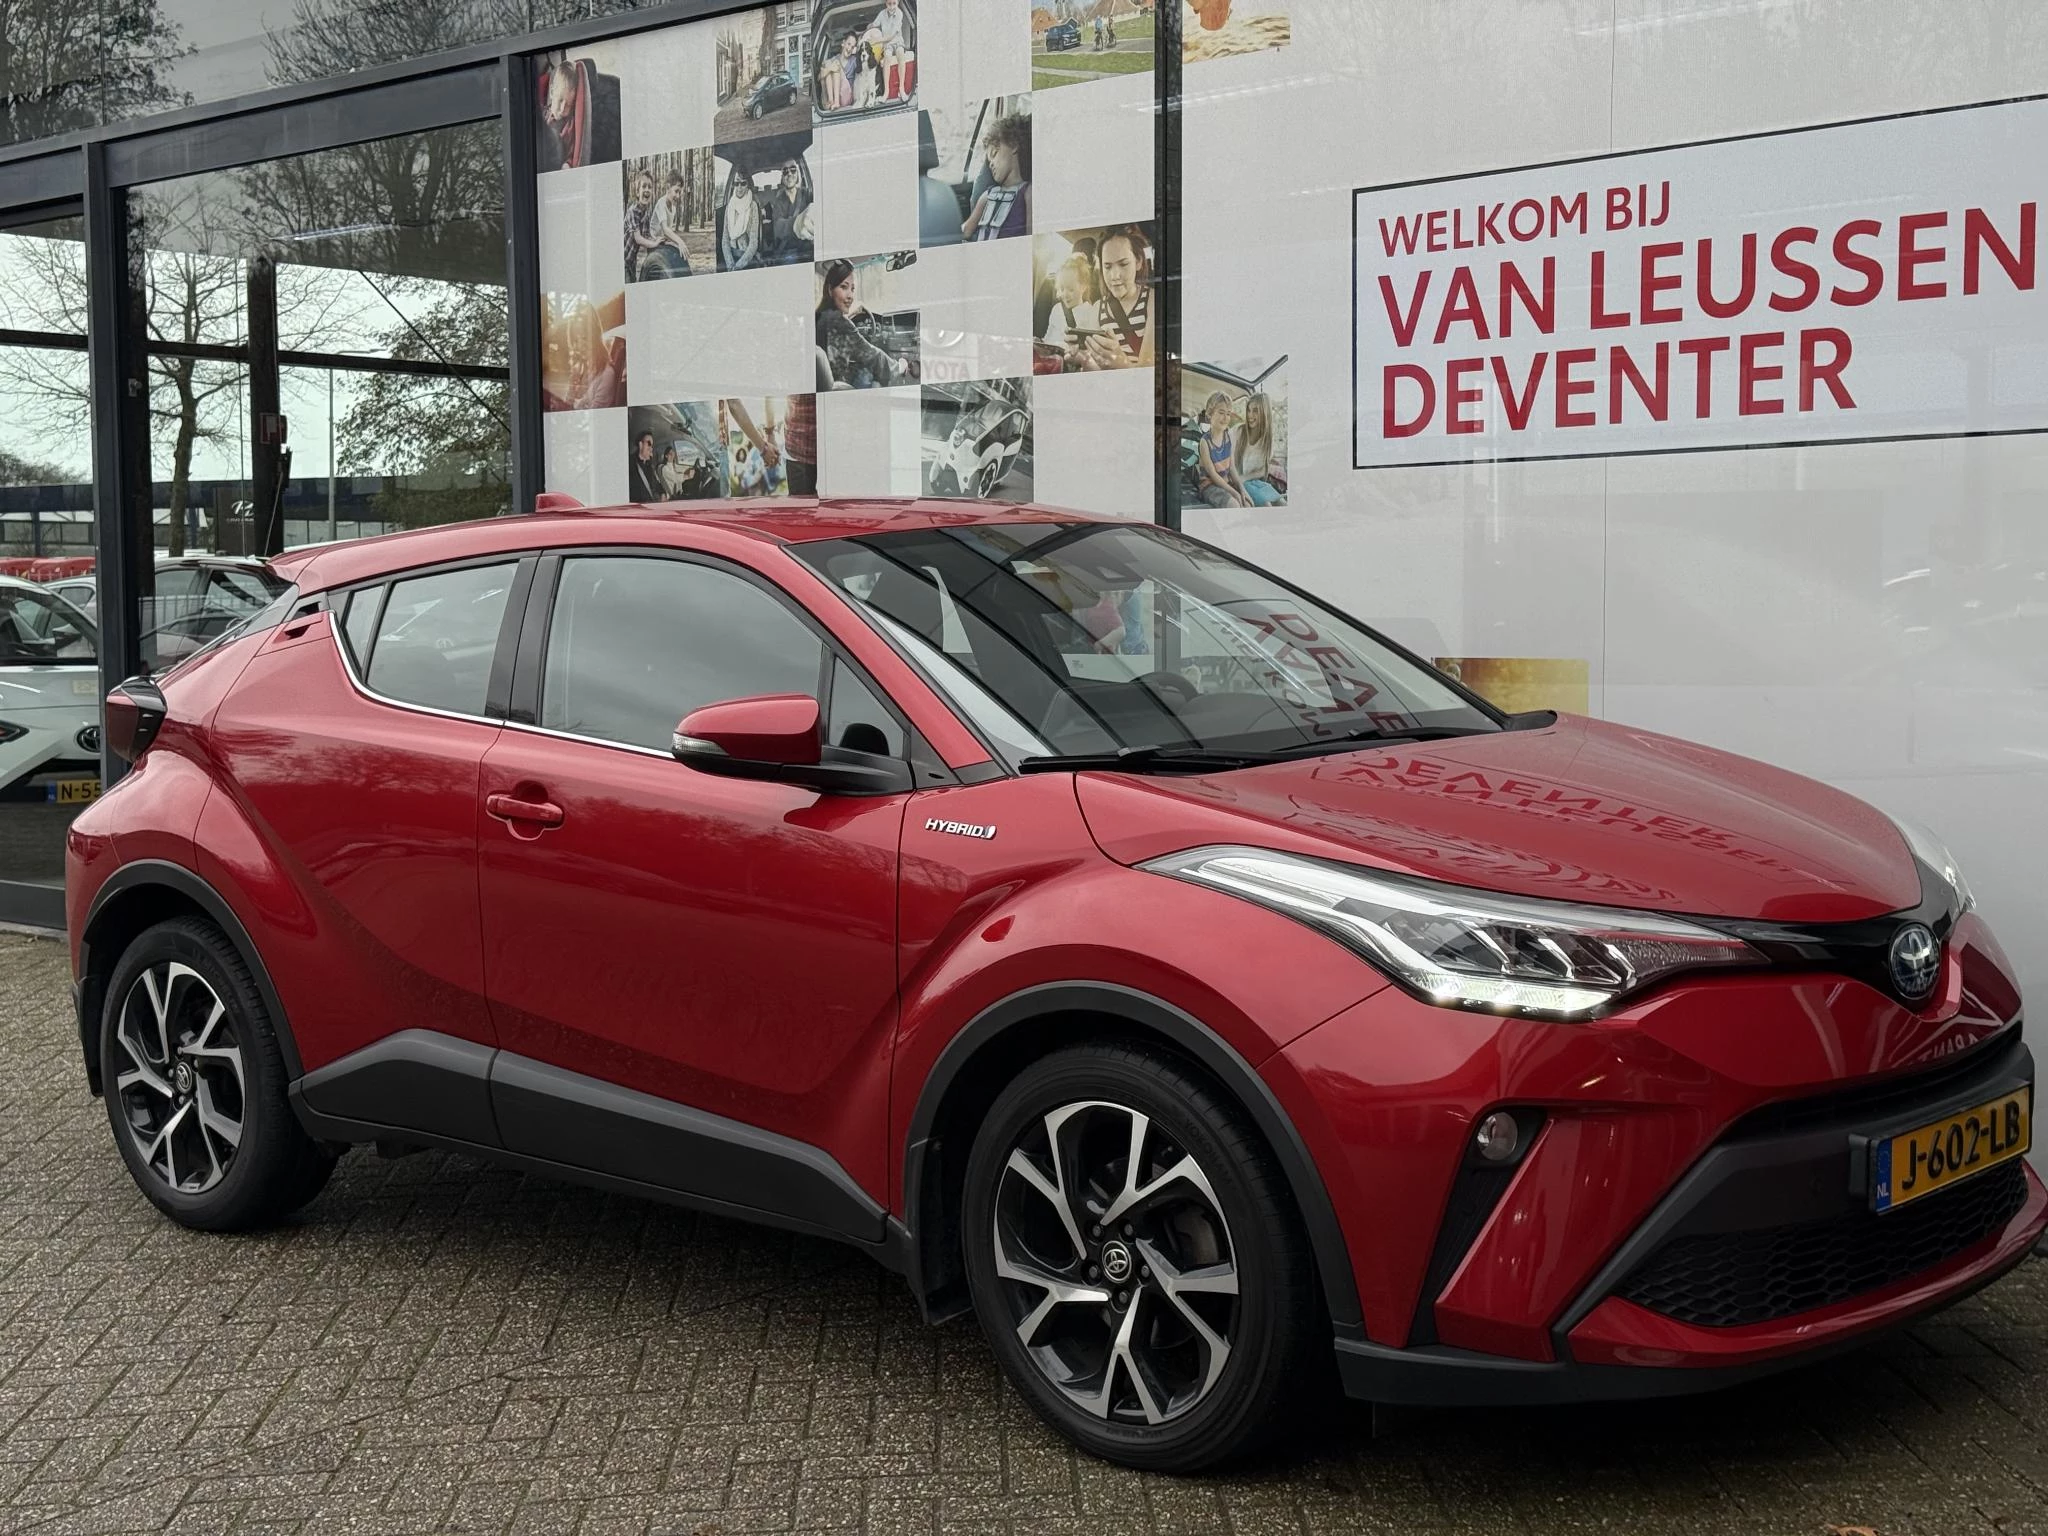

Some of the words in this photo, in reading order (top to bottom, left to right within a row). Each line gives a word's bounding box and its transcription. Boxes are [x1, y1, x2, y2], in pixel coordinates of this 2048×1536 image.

[1379, 192, 1589, 258] WELKOM
[1606, 180, 1671, 232] BIJ
[1379, 256, 1556, 347] VAN
[1590, 201, 2037, 331] LEUSSEN
[1382, 326, 1858, 439] DEVENTER
[925, 818, 983, 838] HYBRID
[1902, 1100, 2020, 1190] J-602-LB
[1877, 1183, 1889, 1199] NL
